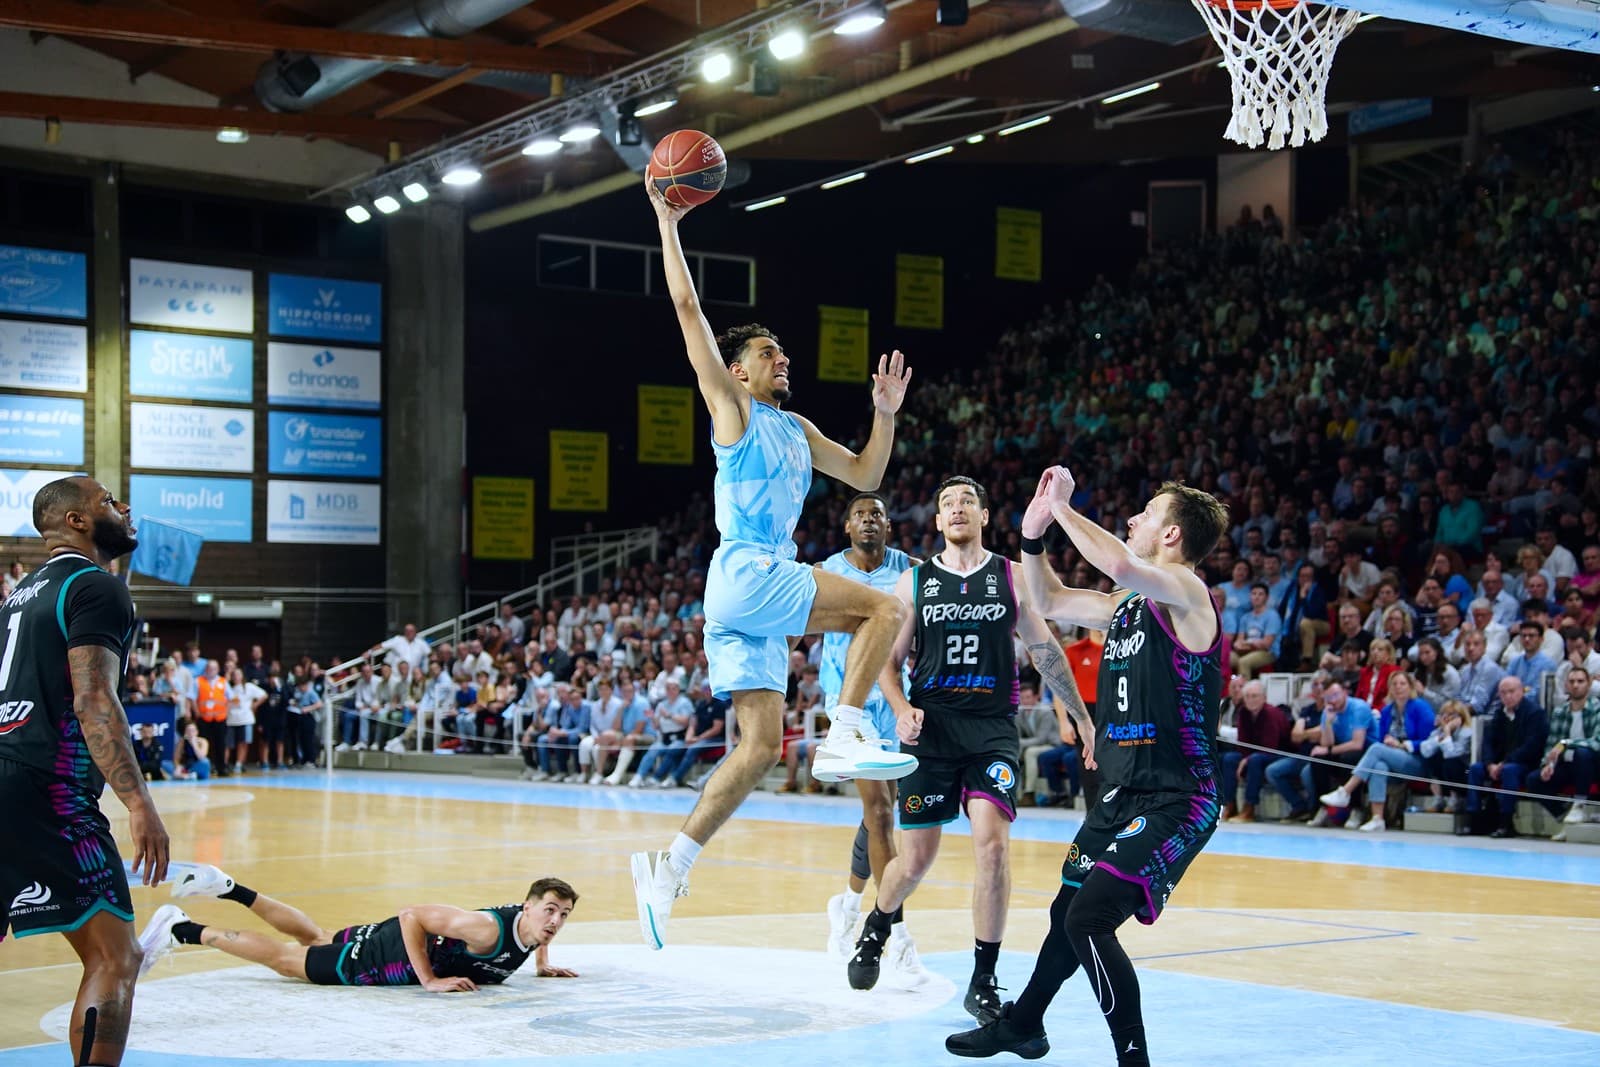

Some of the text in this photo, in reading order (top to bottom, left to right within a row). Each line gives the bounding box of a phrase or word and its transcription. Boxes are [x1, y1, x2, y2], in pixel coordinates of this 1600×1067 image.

[138, 274, 243, 295] PATAPAIN
[278, 306, 372, 326] HIPPODROME
[288, 369, 360, 389] chronos
[316, 493, 359, 511] MDB
[922, 602, 1007, 627] PERIGORD
[0, 610, 22, 692] 1
[946, 634, 980, 665] 22
[1117, 676, 1129, 712] 9
[924, 794, 945, 807] gie
